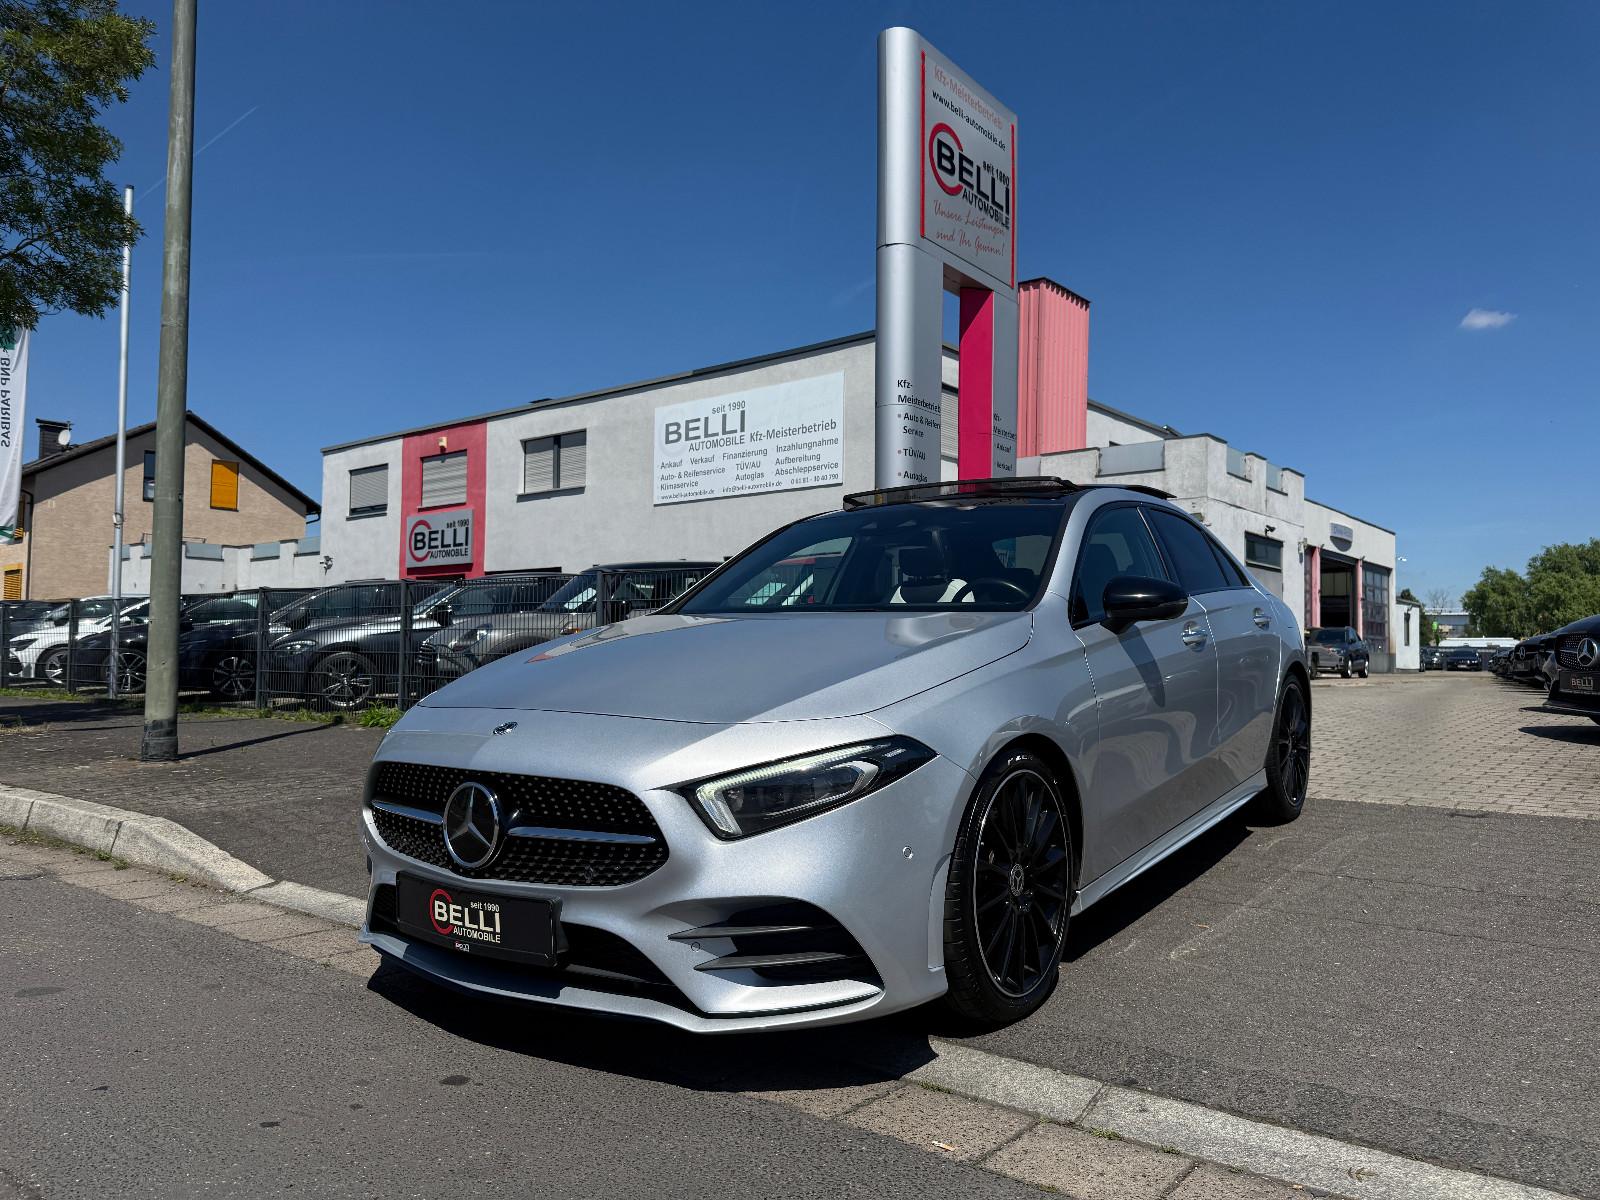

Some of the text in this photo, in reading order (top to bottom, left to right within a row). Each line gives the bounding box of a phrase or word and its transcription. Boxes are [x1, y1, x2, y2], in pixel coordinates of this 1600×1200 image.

[934, 64, 1004, 129] Kfz-Meisterbetrieb
[932, 90, 1006, 151] www.belli-automobile.de
[983, 161, 995, 175] seit
[937, 138, 1010, 216] BELLI
[934, 200, 961, 222] Unsere
[962, 188, 1010, 230] AUTOMOBILE
[936, 229, 956, 241] sind
[897, 379, 913, 389] Kfz-
[712, 400, 746, 415] seit 1990
[897, 394, 941, 413] Meisterbetrieb
[903, 412, 919, 423] Auto
[919, 416, 924, 424] &
[665, 409, 746, 445] BELLI
[749, 418, 837, 443] Kfz-Meisterbetrieb
[688, 434, 745, 453] AUTOMOBILE
[660, 436, 839, 470] Ankauf Verkauf Finanzierung Inzahlungnahme
[775, 453, 821, 466] Aufbereitung
[677, 471, 683, 479] &
[683, 467, 726, 478] Reifenservice
[735, 460, 761, 471] TÜV/AU
[775, 461, 839, 477] Abschleppservice
[735, 472, 765, 482] Autoglas
[660, 480, 699, 491] Klimaservice
[446, 520, 456, 529] seit
[413, 526, 469, 551] BELLI
[429, 547, 469, 559] AUTOMOBILE
[470, 901, 500, 912] seit 1990
[434, 899, 501, 933] BELLI
[453, 925, 501, 943] AUTOMOBILE
